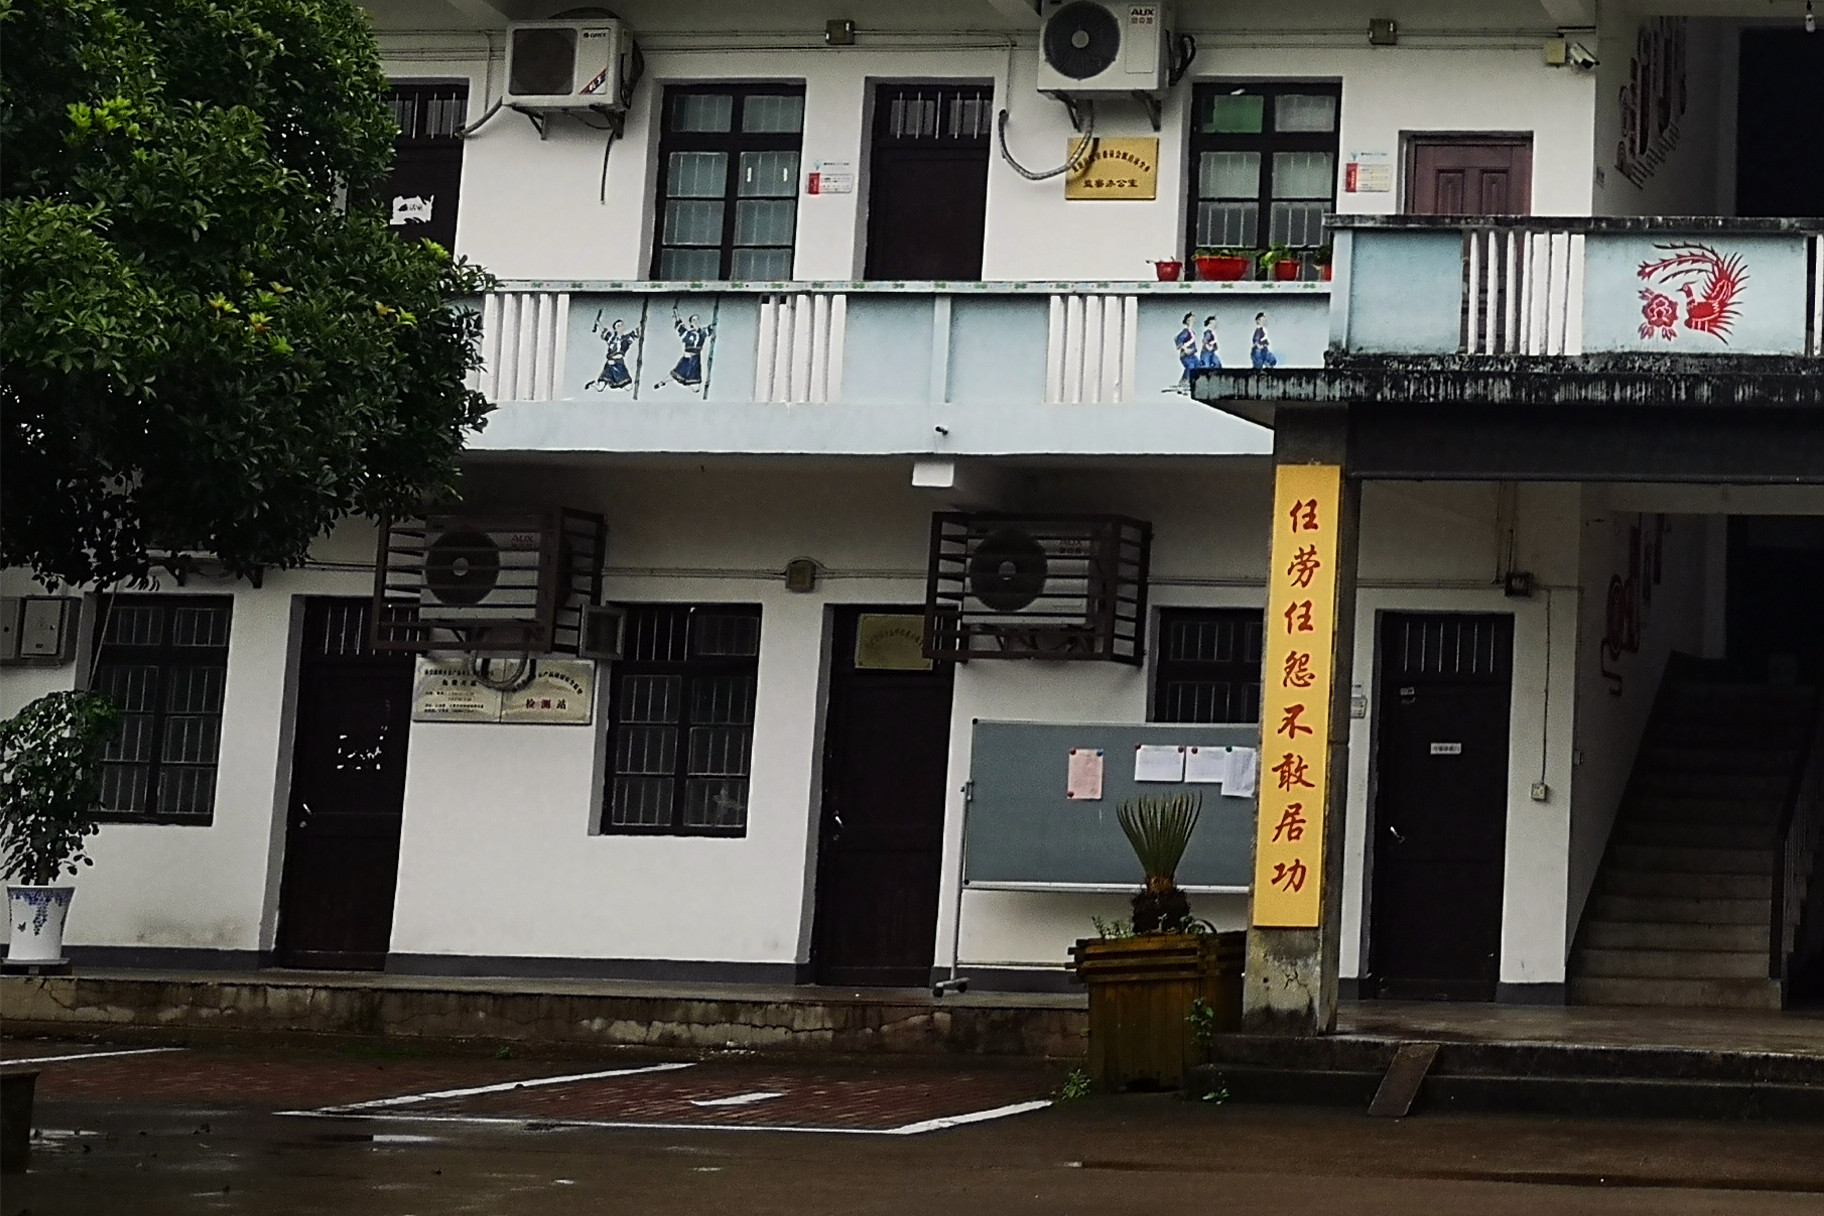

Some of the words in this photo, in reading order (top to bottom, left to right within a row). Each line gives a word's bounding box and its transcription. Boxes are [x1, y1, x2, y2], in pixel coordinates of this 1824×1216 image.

[526, 698, 568, 710] 检测站
[1270, 498, 1321, 894] 任劳任怨不敢居功
